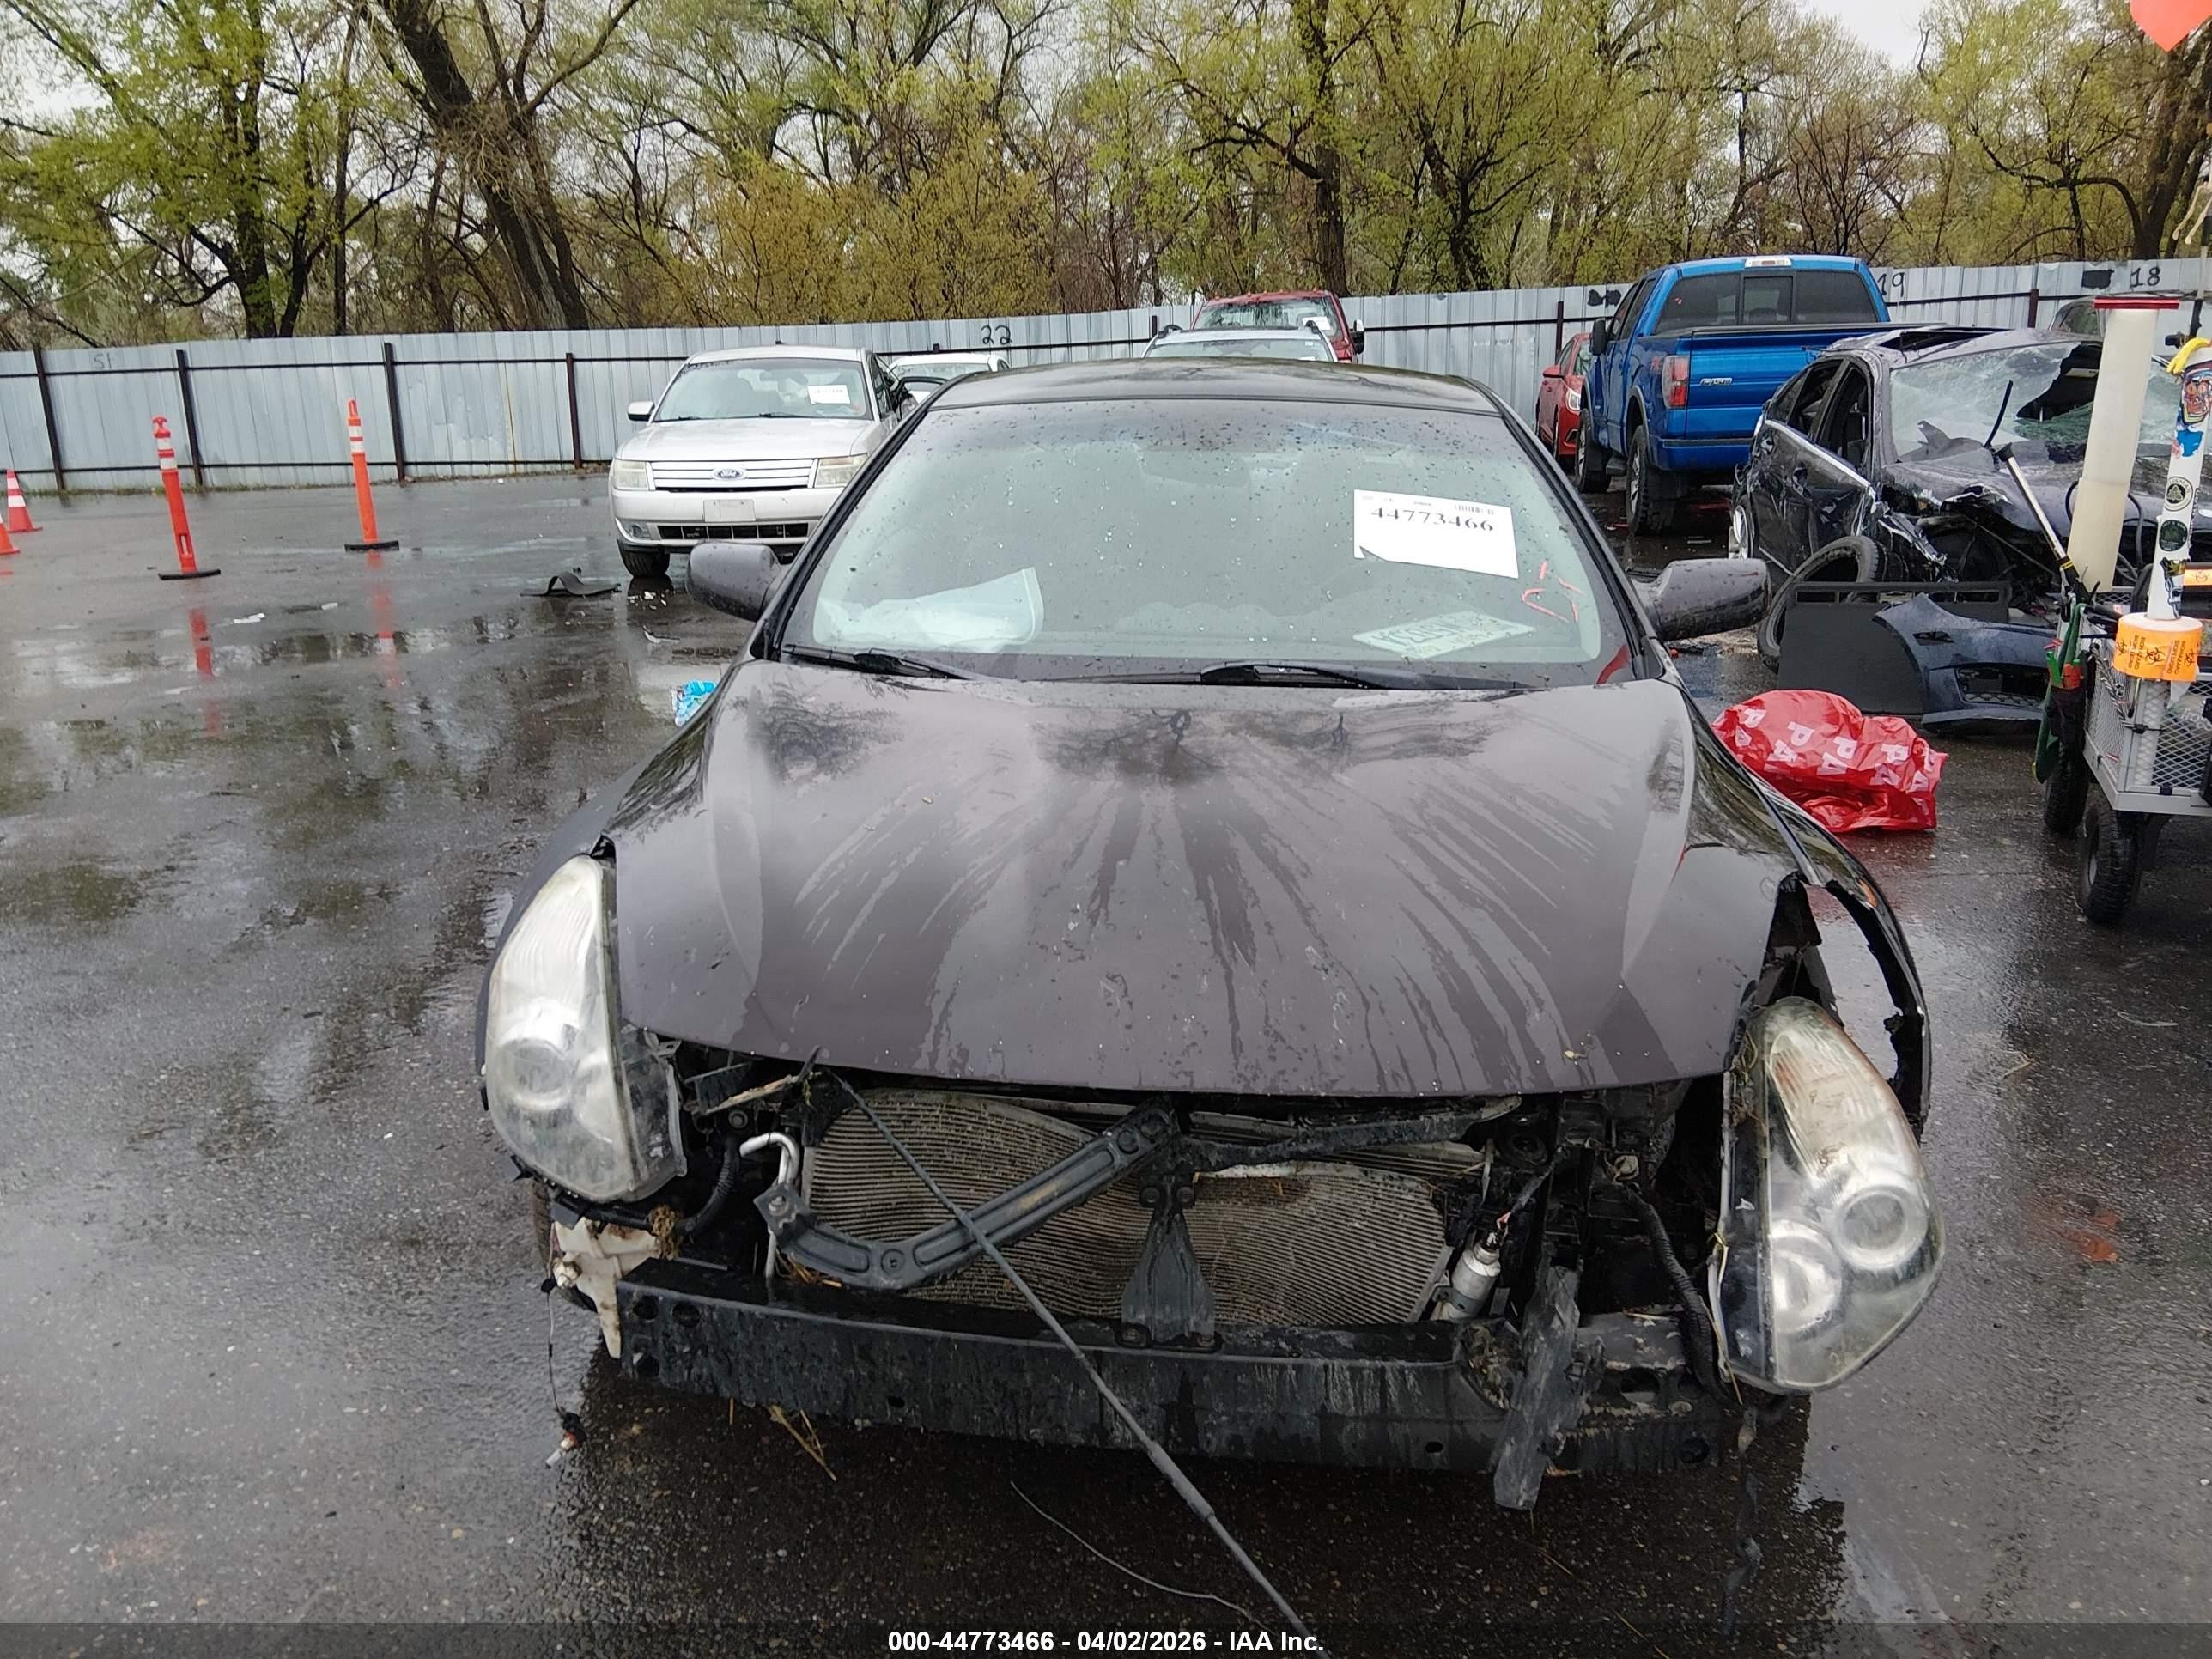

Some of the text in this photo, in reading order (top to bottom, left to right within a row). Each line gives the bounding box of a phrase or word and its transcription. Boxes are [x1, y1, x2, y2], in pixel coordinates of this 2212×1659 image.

[1877, 271, 1905, 298] 19
[2129, 267, 2161, 289] 18
[981, 325, 1013, 345] 22
[1370, 507, 1493, 531] 44773466
